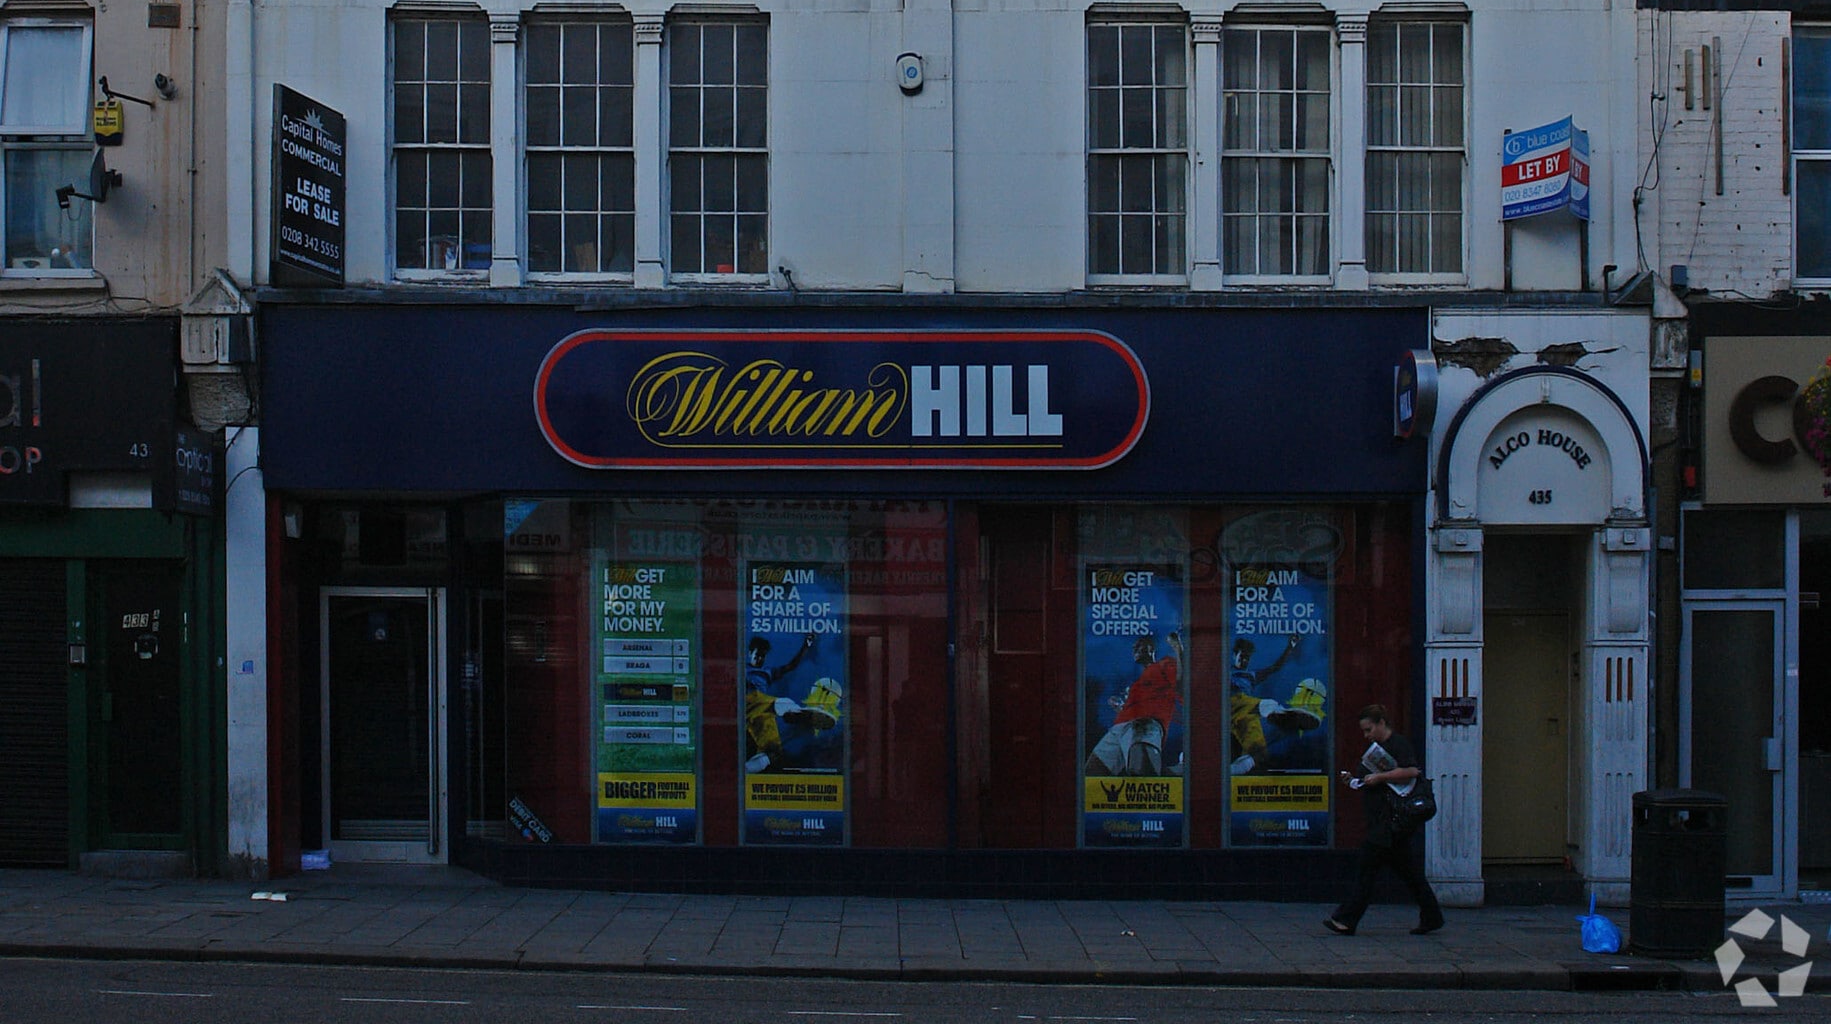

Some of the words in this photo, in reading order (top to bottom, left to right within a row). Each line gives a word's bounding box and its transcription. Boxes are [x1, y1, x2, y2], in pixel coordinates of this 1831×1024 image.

[282, 114, 313, 142] Capital
[316, 130, 342, 156] Homes
[1527, 133, 1548, 149] blue
[282, 138, 342, 176] COMMERCIAL
[1518, 160, 1541, 180] LET
[1545, 154, 1561, 175] BY
[297, 177, 331, 205] LEASE
[1505, 190, 1521, 203] 020
[1522, 184, 1542, 199] 8347
[285, 193, 309, 216] FOR
[313, 203, 340, 227] SALE
[281, 226, 303, 245] 0208
[304, 234, 319, 252] 342
[320, 240, 340, 259] 5555
[626, 350, 908, 450] William
[911, 364, 1064, 437] HILL
[1489, 431, 1530, 470] ALCO
[1537, 429, 1592, 470] HOUSE
[1528, 489, 1552, 505] 435
[604, 568, 609, 583] I
[635, 568, 665, 584] GET
[752, 568, 758, 584] I
[782, 569, 815, 584] AIM
[1091, 571, 1097, 587] I
[1122, 571, 1154, 587] GET
[1235, 570, 1241, 585] I
[1266, 570, 1299, 586] AIM
[604, 584, 652, 600] MORE
[752, 585, 785, 601] FOR
[788, 585, 801, 601] A
[1091, 587, 1140, 603] MORE
[1235, 586, 1269, 602] FOR
[1272, 586, 1285, 602] A
[604, 601, 636, 617] FOR
[640, 601, 666, 617] MY
[751, 601, 804, 617] SHARE
[808, 602, 831, 617] OF
[1091, 604, 1158, 620] SPECIAL
[1235, 602, 1288, 618] SHARE
[1292, 603, 1315, 618] OF
[604, 617, 665, 633] MONEY.
[751, 618, 772, 633] £5
[774, 618, 842, 634] MILLION.
[1091, 620, 1154, 636] OFFERS.
[1235, 619, 1256, 635] £5
[1259, 619, 1326, 635] MILLION.
[605, 781, 657, 799] BIGGER
[1126, 783, 1170, 793] MATCH
[1126, 793, 1170, 803] WINNER
[655, 816, 678, 828] HILL
[803, 818, 825, 830] HILL
[1142, 820, 1165, 832] HILL
[1288, 819, 1310, 831] HILL
[528, 818, 551, 844] CARD
